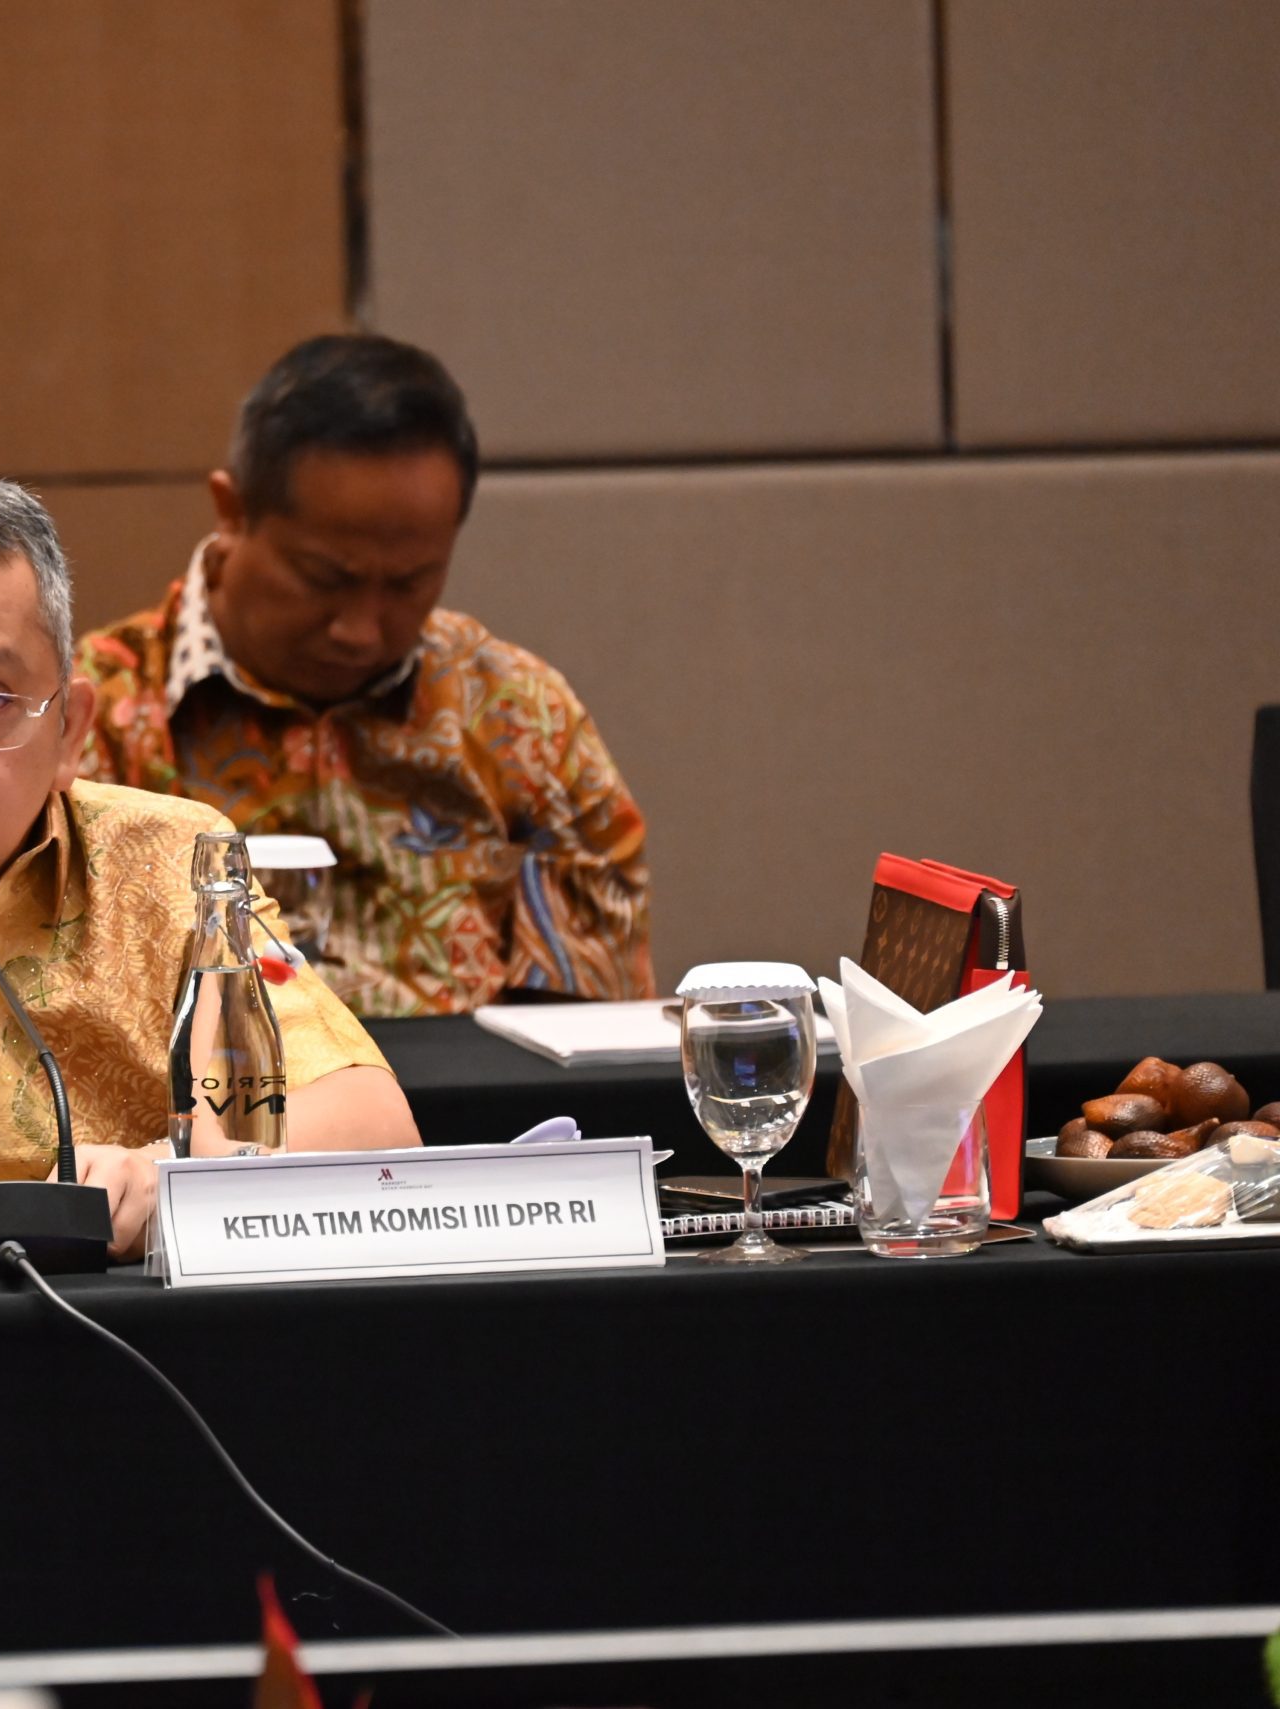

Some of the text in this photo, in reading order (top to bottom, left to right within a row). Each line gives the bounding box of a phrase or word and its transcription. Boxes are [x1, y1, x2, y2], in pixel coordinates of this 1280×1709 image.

[223, 1199, 596, 1239] KETUA TIM KOMISI III DPR RI
